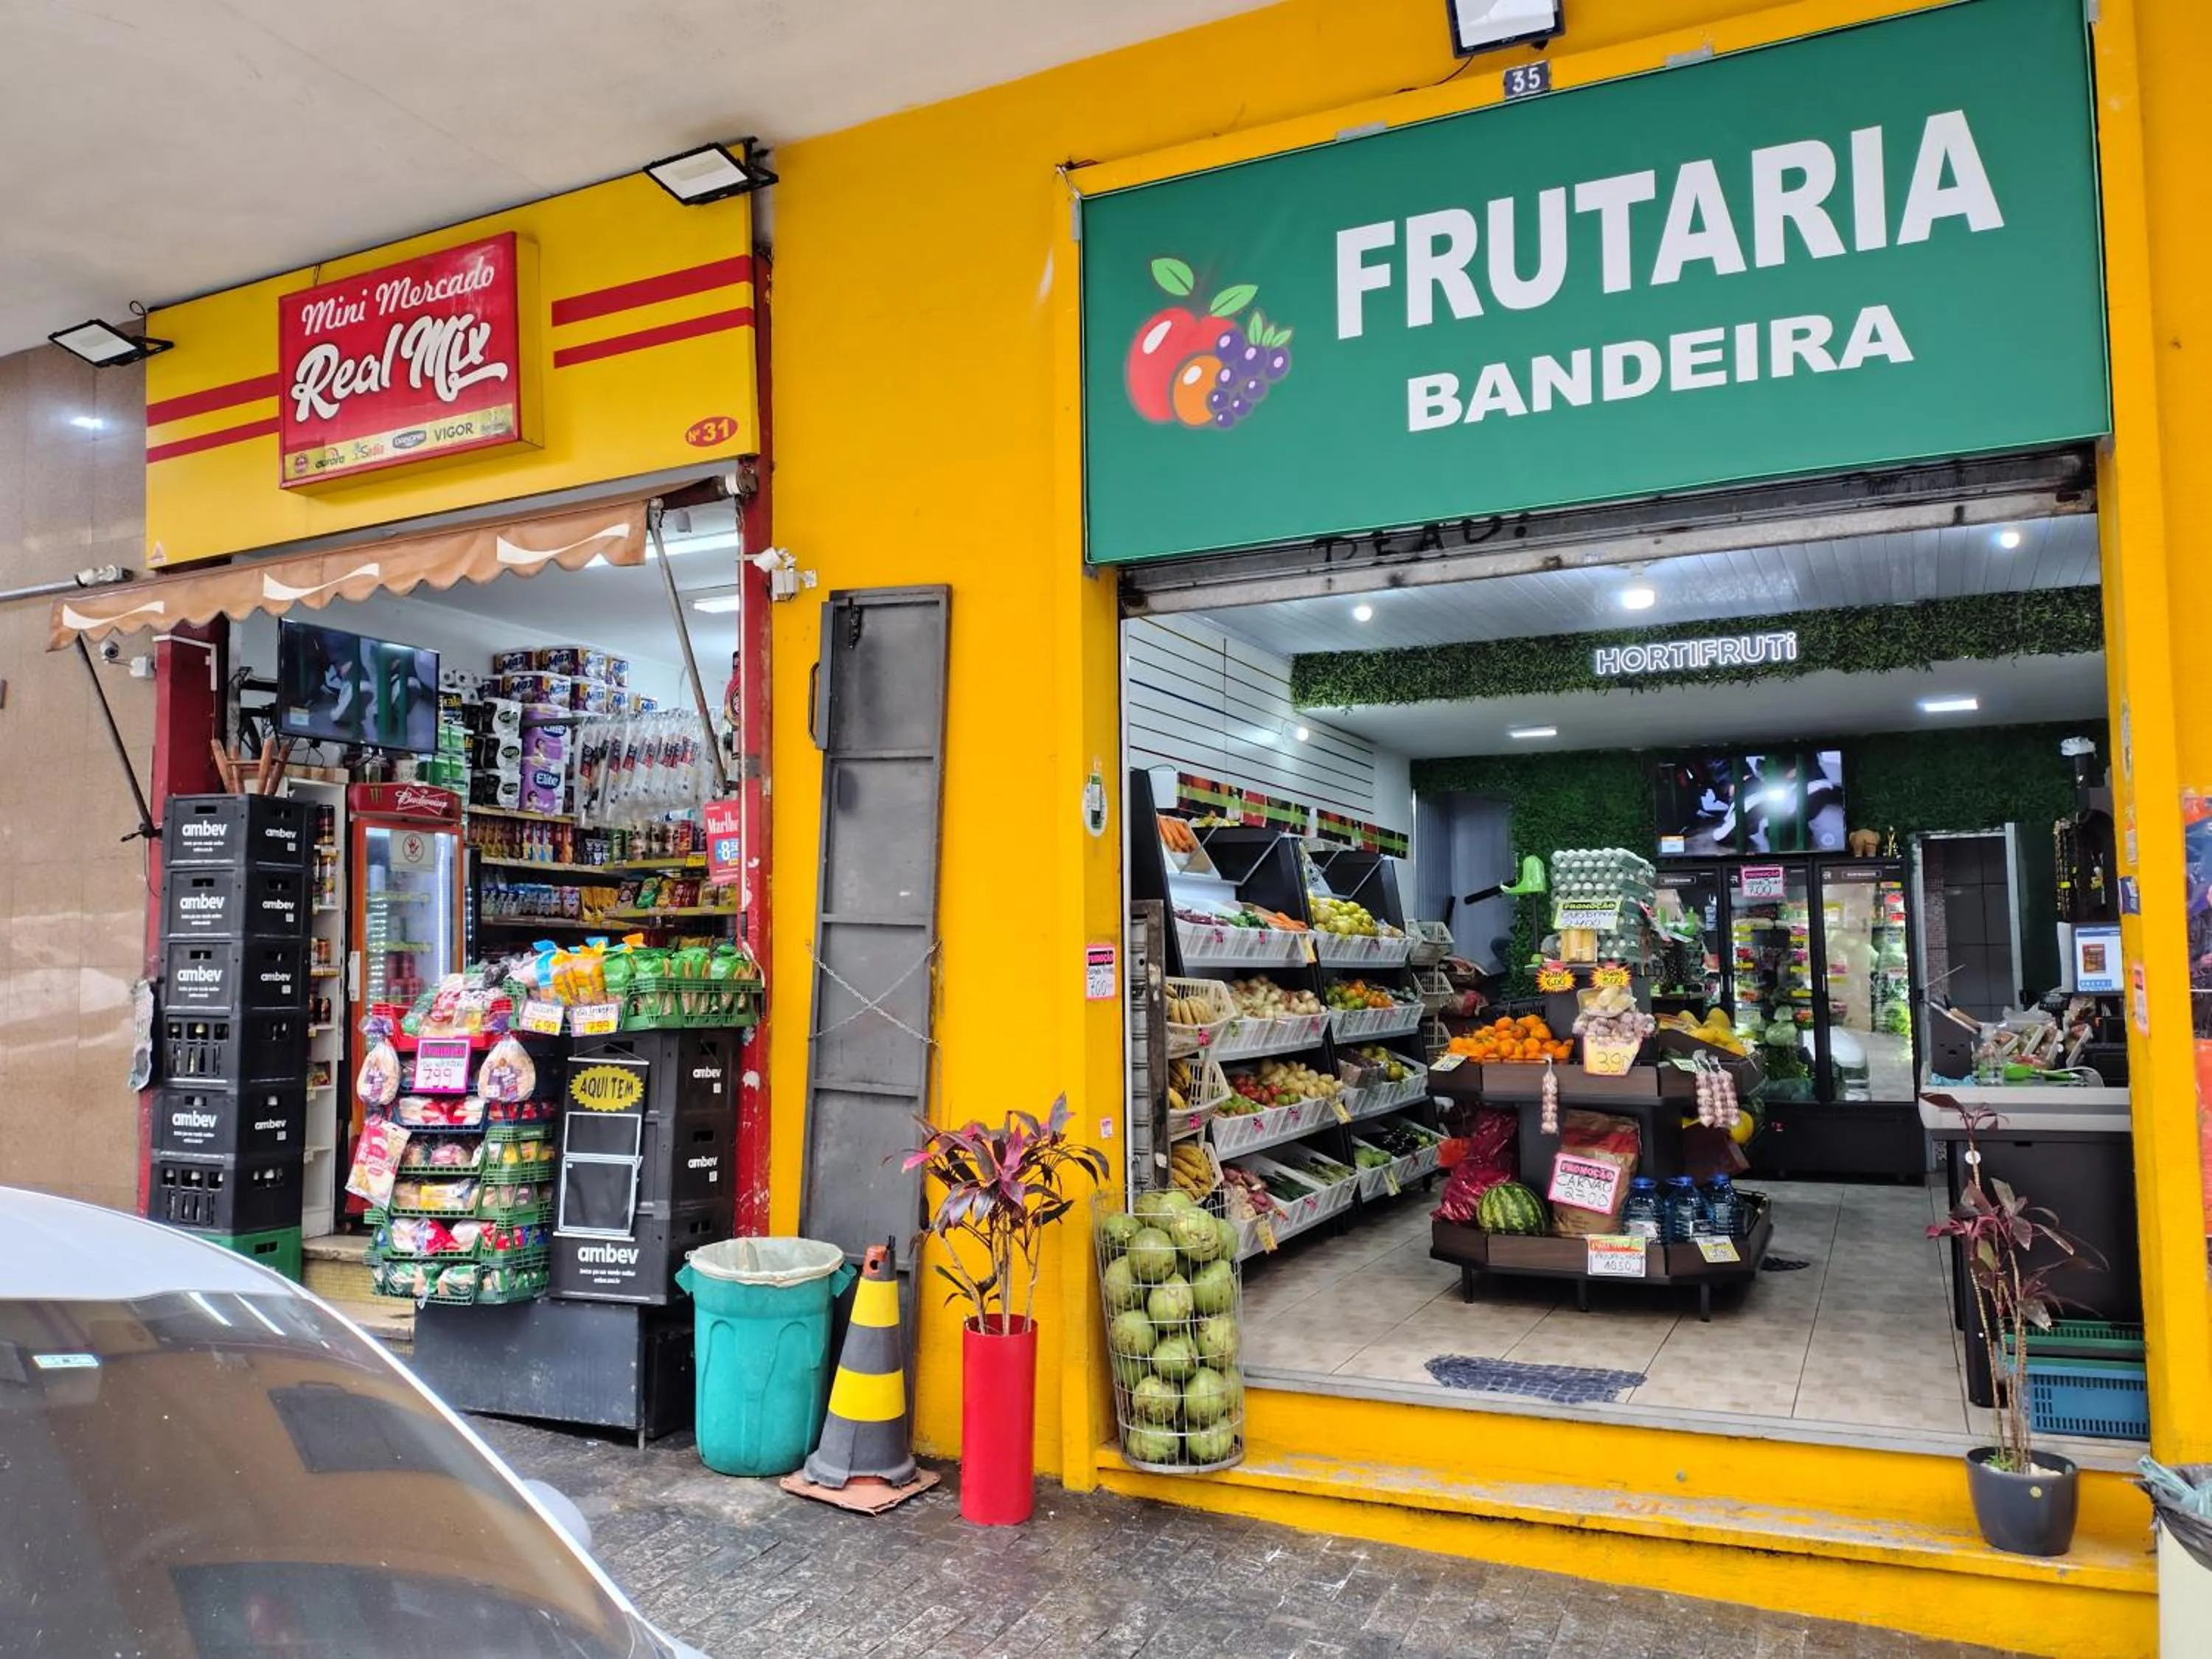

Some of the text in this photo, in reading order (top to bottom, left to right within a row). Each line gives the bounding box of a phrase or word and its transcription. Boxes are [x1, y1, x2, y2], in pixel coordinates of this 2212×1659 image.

[1512, 67, 1540, 92] 35
[1336, 109, 2004, 341] FRUTARIA
[302, 256, 494, 335] Mini Mercado
[291, 312, 509, 423] Real Mix
[1408, 305, 1915, 432] BANDEIRA
[434, 422, 474, 441] VIGOR
[703, 418, 729, 442] 31
[537, 774, 559, 787] Elite
[182, 820, 228, 837] ambev
[265, 828, 296, 839] ambev
[180, 894, 225, 910] ambev
[262, 900, 294, 911] ambev
[178, 966, 223, 982] ambev
[261, 972, 291, 982] ambev
[693, 1066, 722, 1079] ambev
[580, 1076, 633, 1099] AQUI TEM
[172, 1110, 217, 1128] ambev
[254, 1119, 286, 1130] ambev
[688, 1155, 717, 1169] ambev
[1562, 1163, 1614, 1180] PROMOÇÃO
[578, 1242, 639, 1265] ambev
